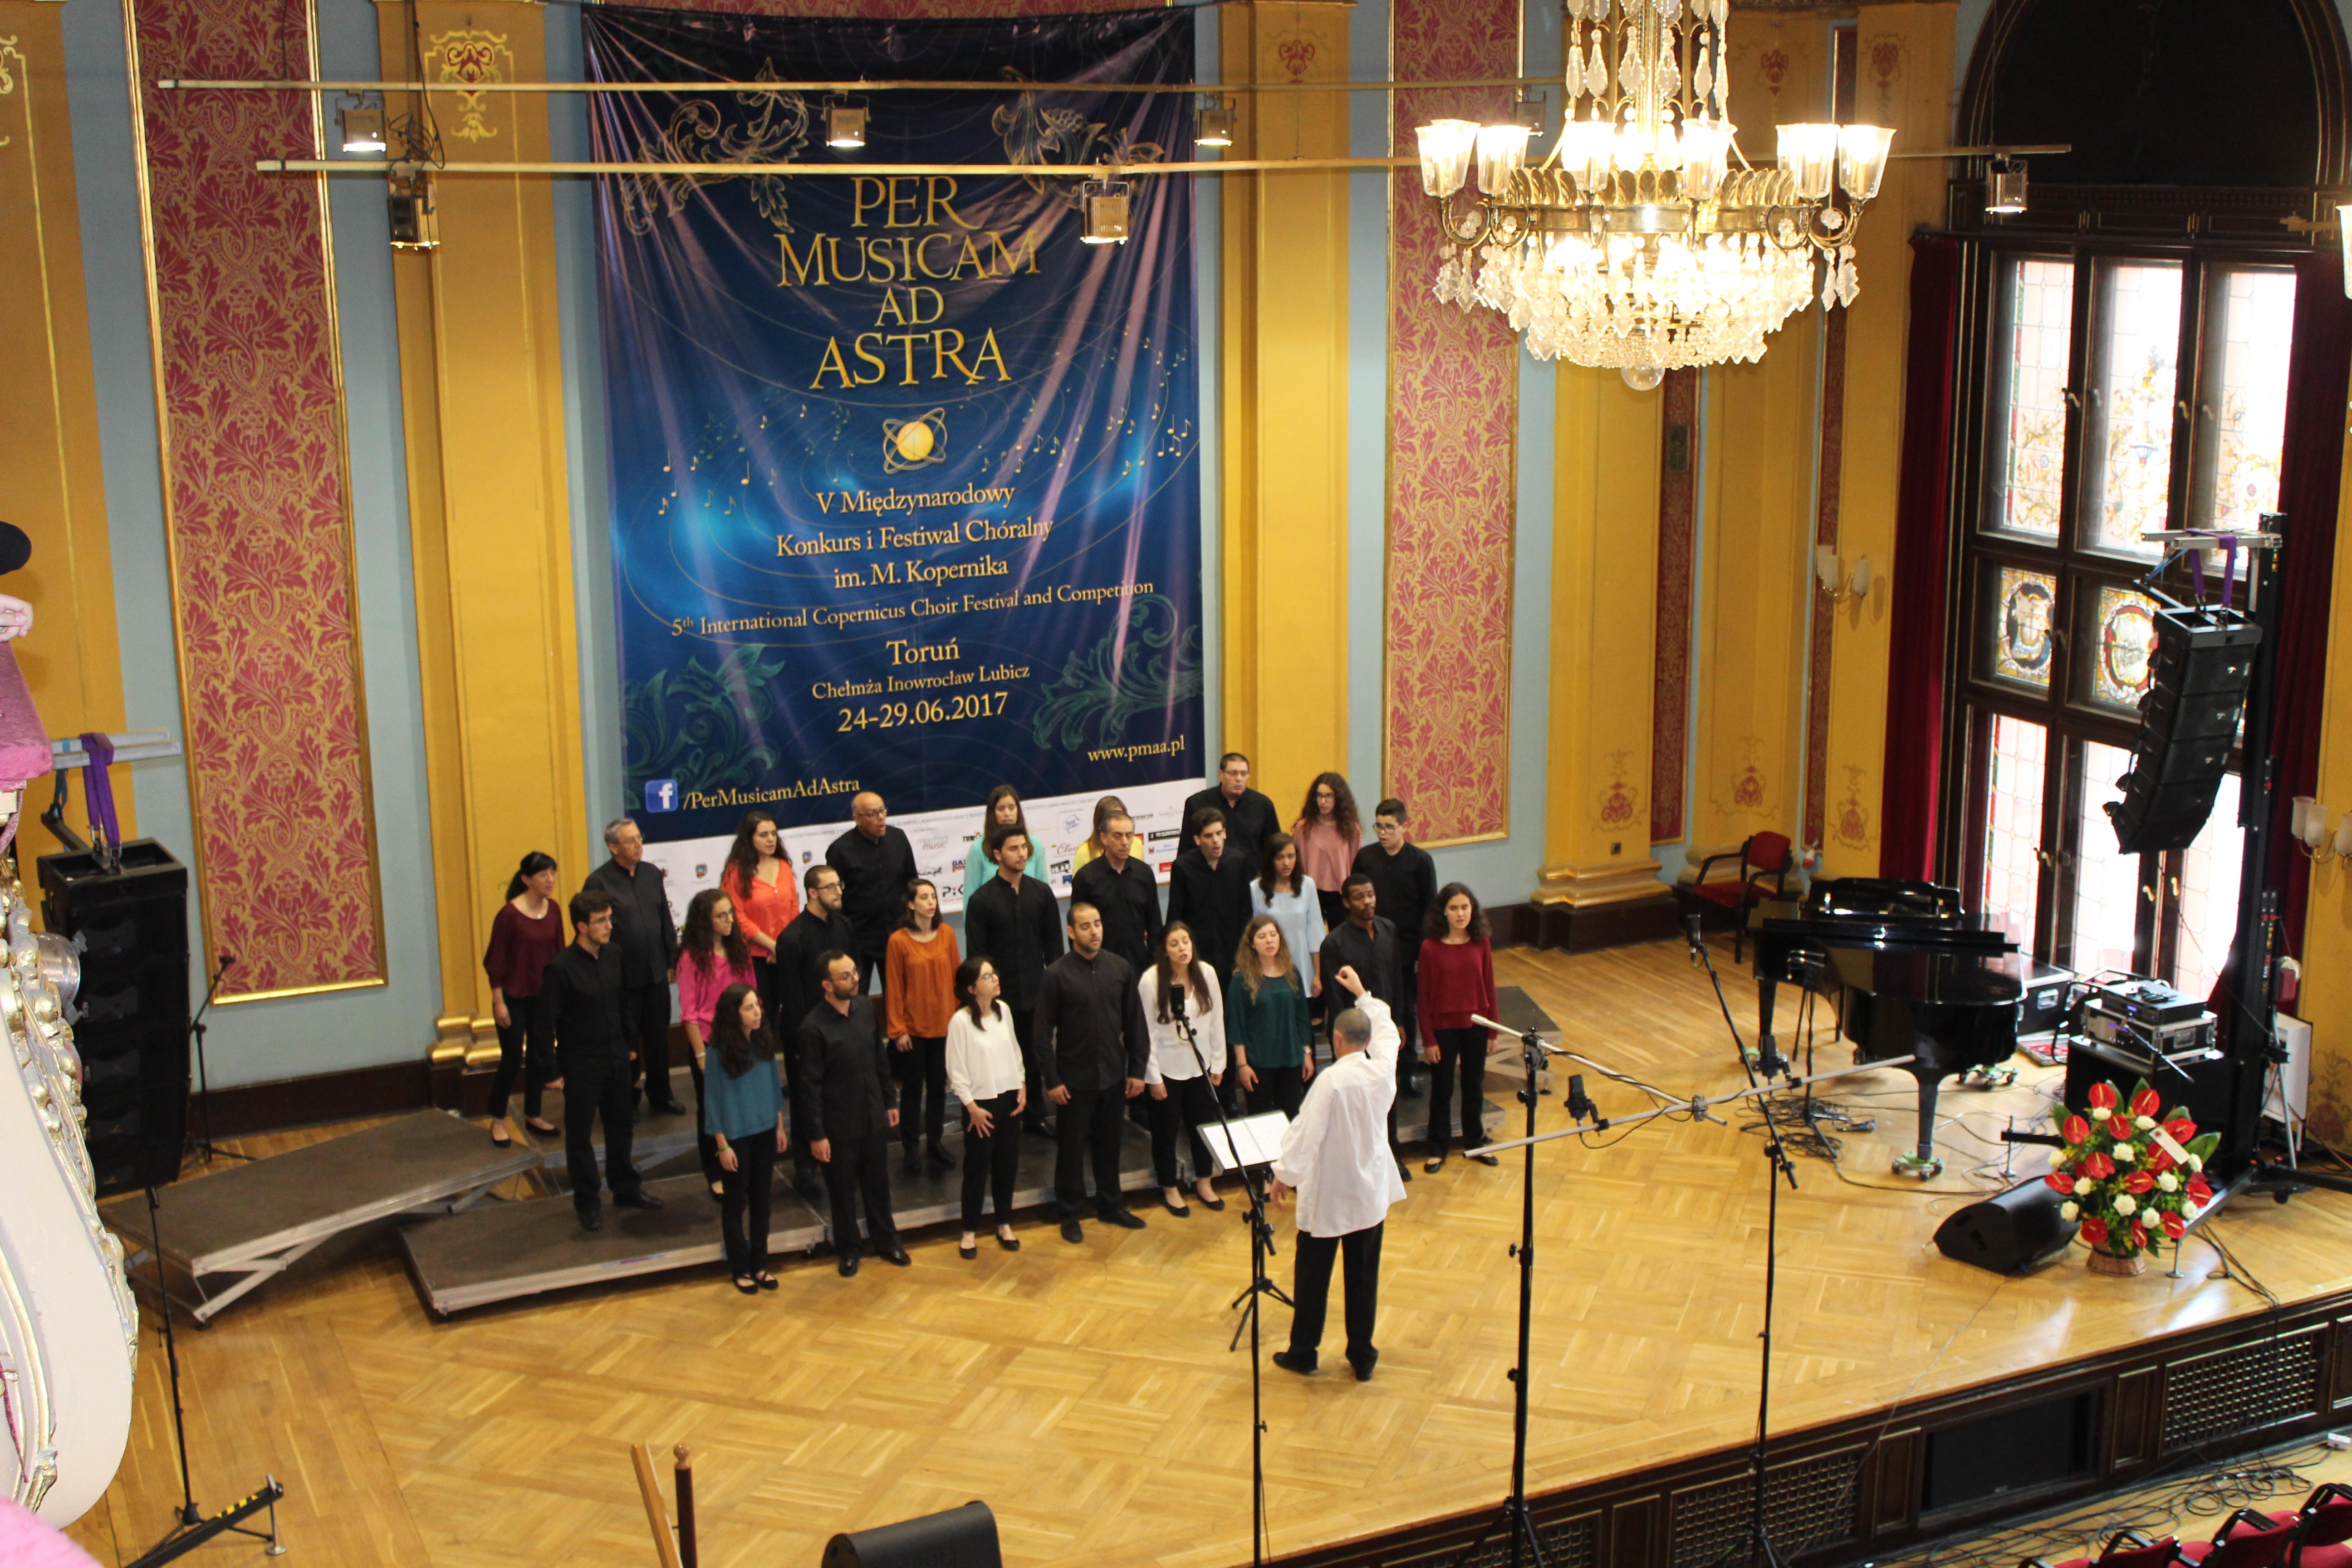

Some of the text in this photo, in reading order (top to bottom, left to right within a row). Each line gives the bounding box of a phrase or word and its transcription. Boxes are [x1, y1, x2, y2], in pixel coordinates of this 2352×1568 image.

[850, 176, 981, 229] PER
[774, 230, 1040, 287] MUSICAM
[875, 286, 944, 326] AD
[809, 328, 1012, 389] ASTRA
[817, 483, 1015, 516] V Międzynarodowy
[776, 516, 1054, 557] Konkurs i Festiwal Chóralny
[834, 554, 1009, 588] im. M. Kopernika
[699, 608, 807, 635] International
[813, 603, 906, 629] Copernicus
[911, 597, 958, 617] Choir
[963, 590, 1019, 612] Festival
[1024, 586, 1052, 605] and
[1057, 579, 1154, 605] Competition
[886, 637, 960, 666] Toruń
[812, 664, 1030, 699] Chełmża Inowrocław Lubicz
[838, 691, 1009, 732] 24-29.06.2017
[1087, 734, 1186, 762] www.pmaa.pl
[683, 777, 861, 810] /PerMusicamAdAstra
[922, 842, 946, 852] music
